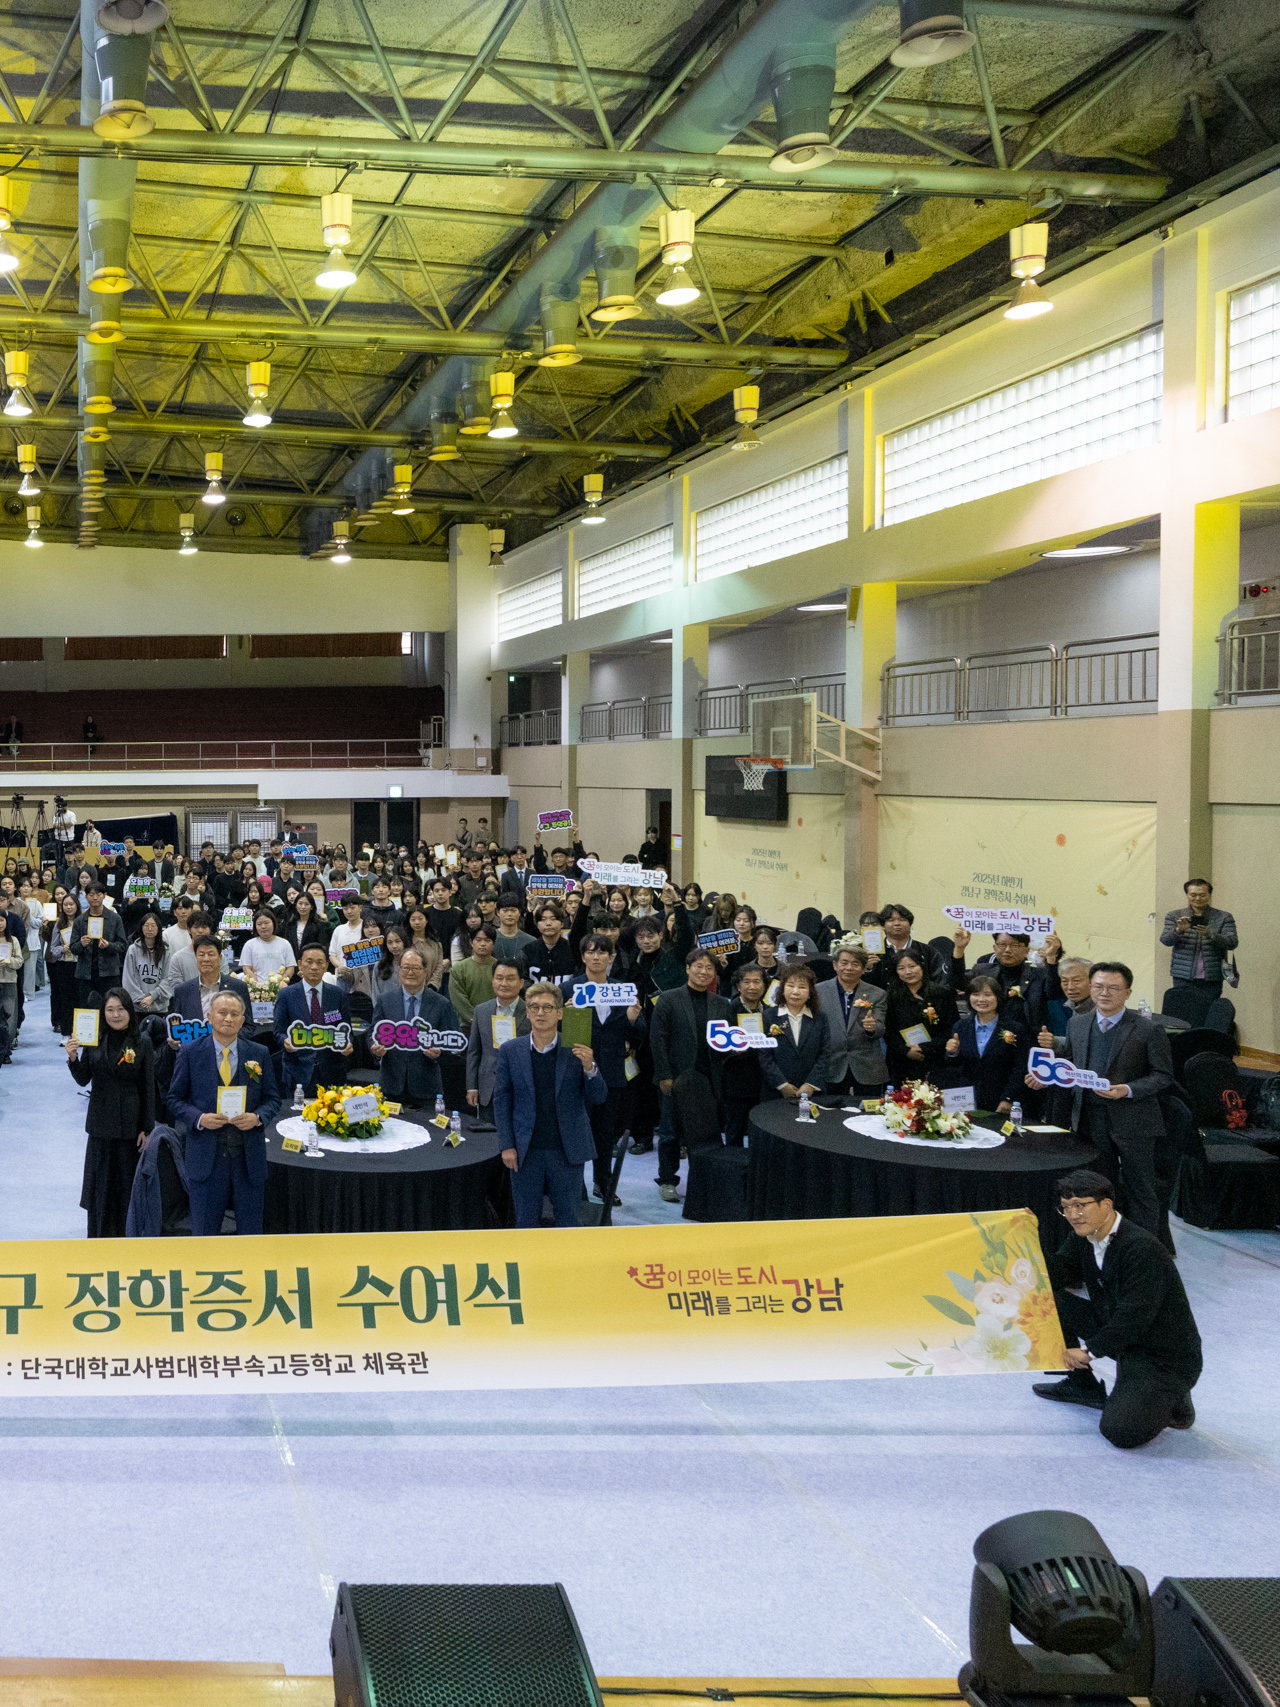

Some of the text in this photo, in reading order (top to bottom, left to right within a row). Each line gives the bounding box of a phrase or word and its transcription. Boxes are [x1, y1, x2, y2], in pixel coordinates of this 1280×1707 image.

[586, 861, 602, 871] 꿈이
[623, 865, 639, 873] 도시
[594, 872, 664, 885] 미래를 그리는 강남
[973, 872, 1023, 889] 2025년 하반기
[960, 886, 1036, 907] 강남구 장학증서 수여식
[954, 908, 1019, 920] 꿈이 모이는 도시
[964, 917, 1052, 932] 미래를 그리는 강남
[599, 986, 635, 997] 강남구
[292, 1027, 345, 1048] 미래를
[378, 1023, 463, 1047] 응원합니다
[643, 1264, 778, 1289] 꿈이 모이는 도시
[64, 1266, 313, 1334] 장학증서
[336, 1262, 524, 1329] 수여식
[668, 1278, 844, 1317] 미래를 그리는 강남
[20, 1354, 356, 1380] 단국대학교사범대학부속고등학교
[362, 1351, 429, 1377] 체육관
